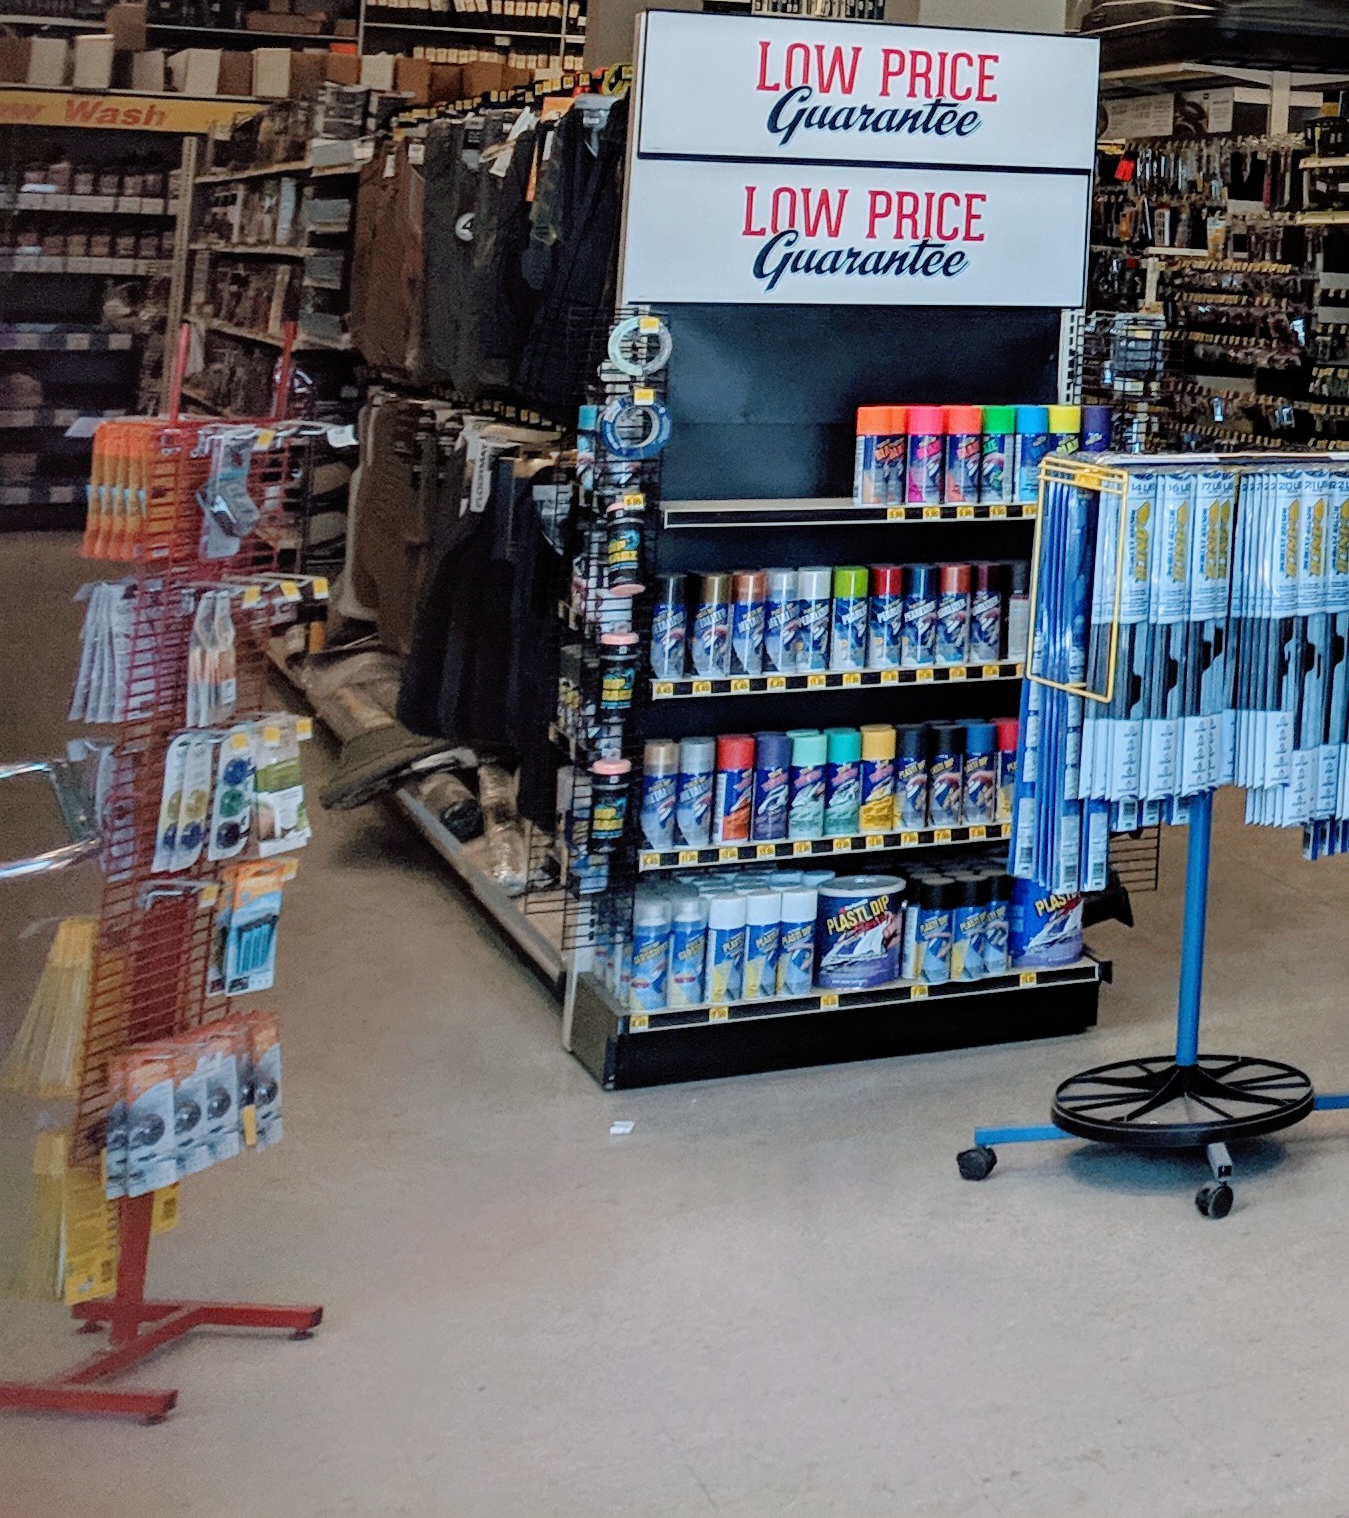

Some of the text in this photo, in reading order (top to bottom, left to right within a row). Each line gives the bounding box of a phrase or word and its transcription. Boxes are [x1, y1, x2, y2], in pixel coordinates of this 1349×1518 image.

[756, 41, 999, 103] LOW PRICE
[62, 99, 167, 127] Wash
[767, 85, 982, 149] Guarantee
[742, 186, 987, 242] LOW PRICE
[752, 229, 971, 294] Guarantee
[871, 894, 890, 917] DIP
[1034, 893, 1077, 918] PLAS
